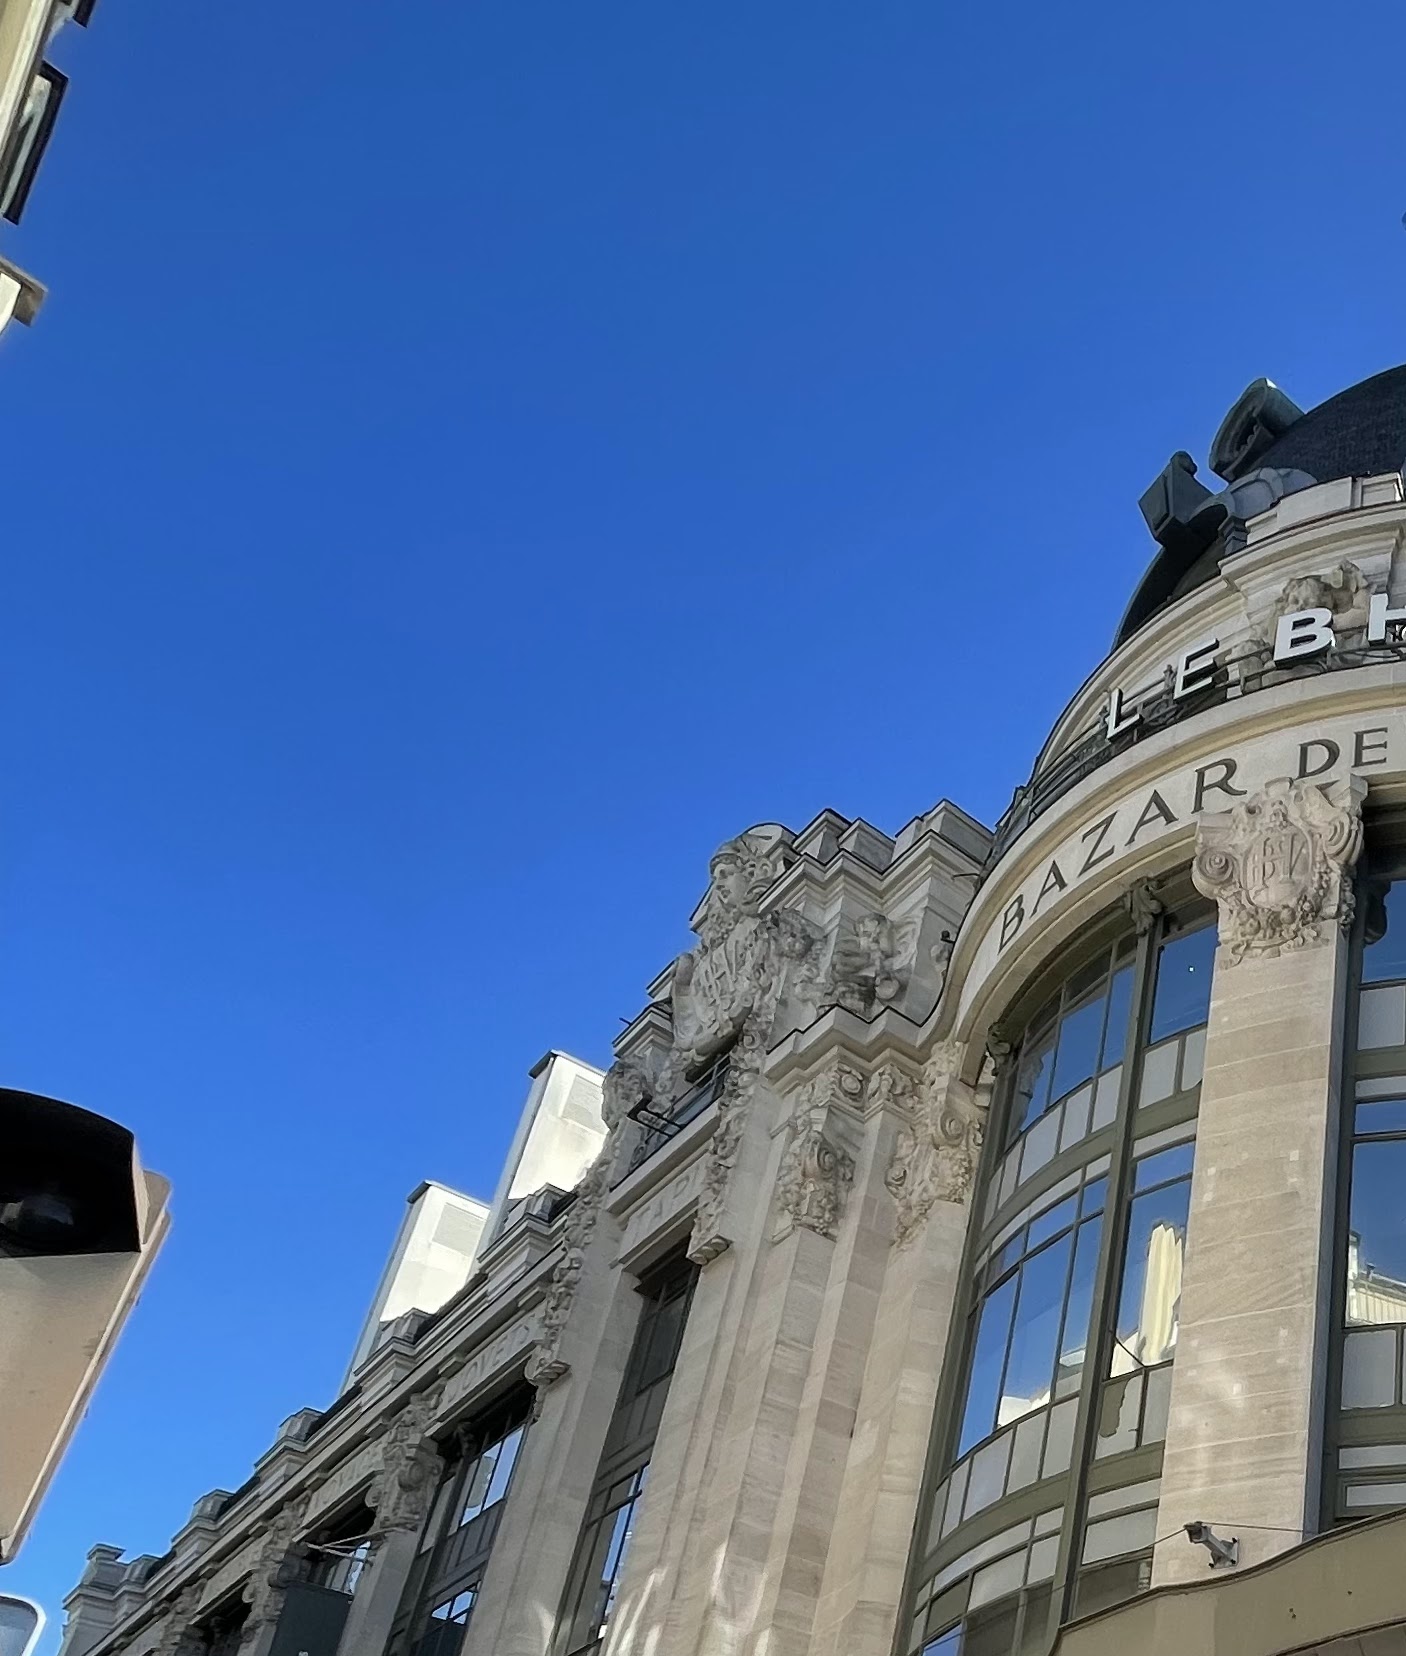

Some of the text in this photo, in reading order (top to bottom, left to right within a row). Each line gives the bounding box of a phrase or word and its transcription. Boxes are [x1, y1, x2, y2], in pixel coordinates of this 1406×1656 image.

[1106, 638, 1220, 742] LE
[998, 757, 1248, 953] BAZAR
[1299, 727, 1389, 780] DE
